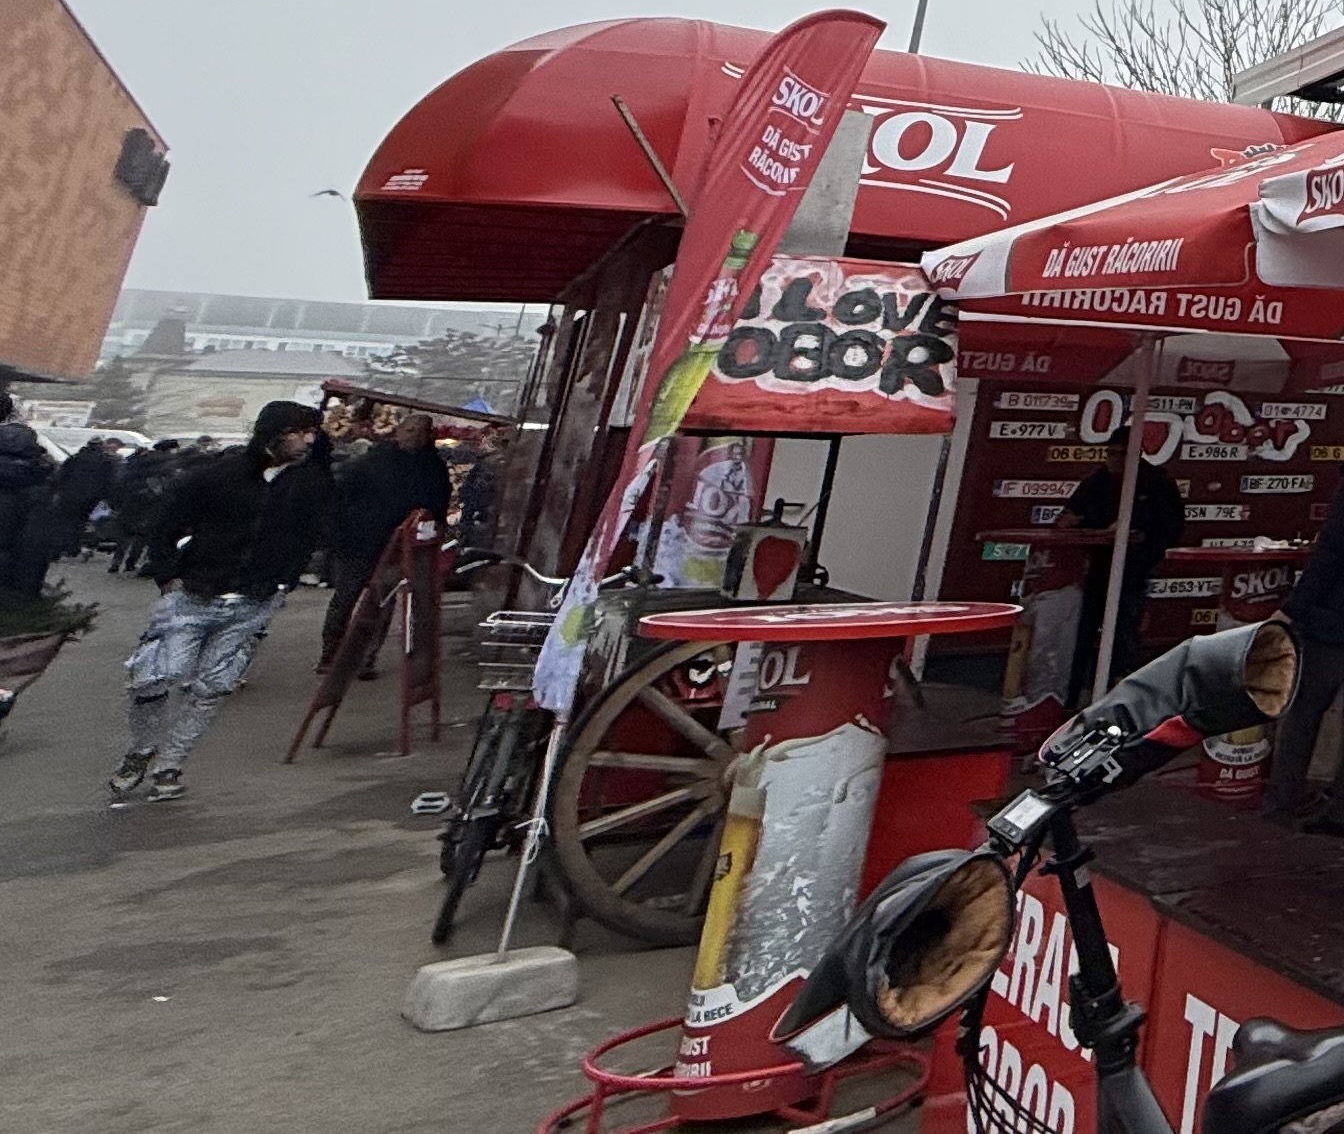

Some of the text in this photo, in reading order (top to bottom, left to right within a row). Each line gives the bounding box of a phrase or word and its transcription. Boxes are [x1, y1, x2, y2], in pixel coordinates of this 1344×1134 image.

[772, 76, 824, 126] SKOL
[761, 124, 783, 151] DĂ
[861, 105, 1015, 184] OL
[1042, 235, 1185, 279] DĂ GUST RĂCORIRII
[717, 322, 956, 397] OBOR
[759, 646, 814, 691] OL
[704, 1002, 735, 1023] RECE
